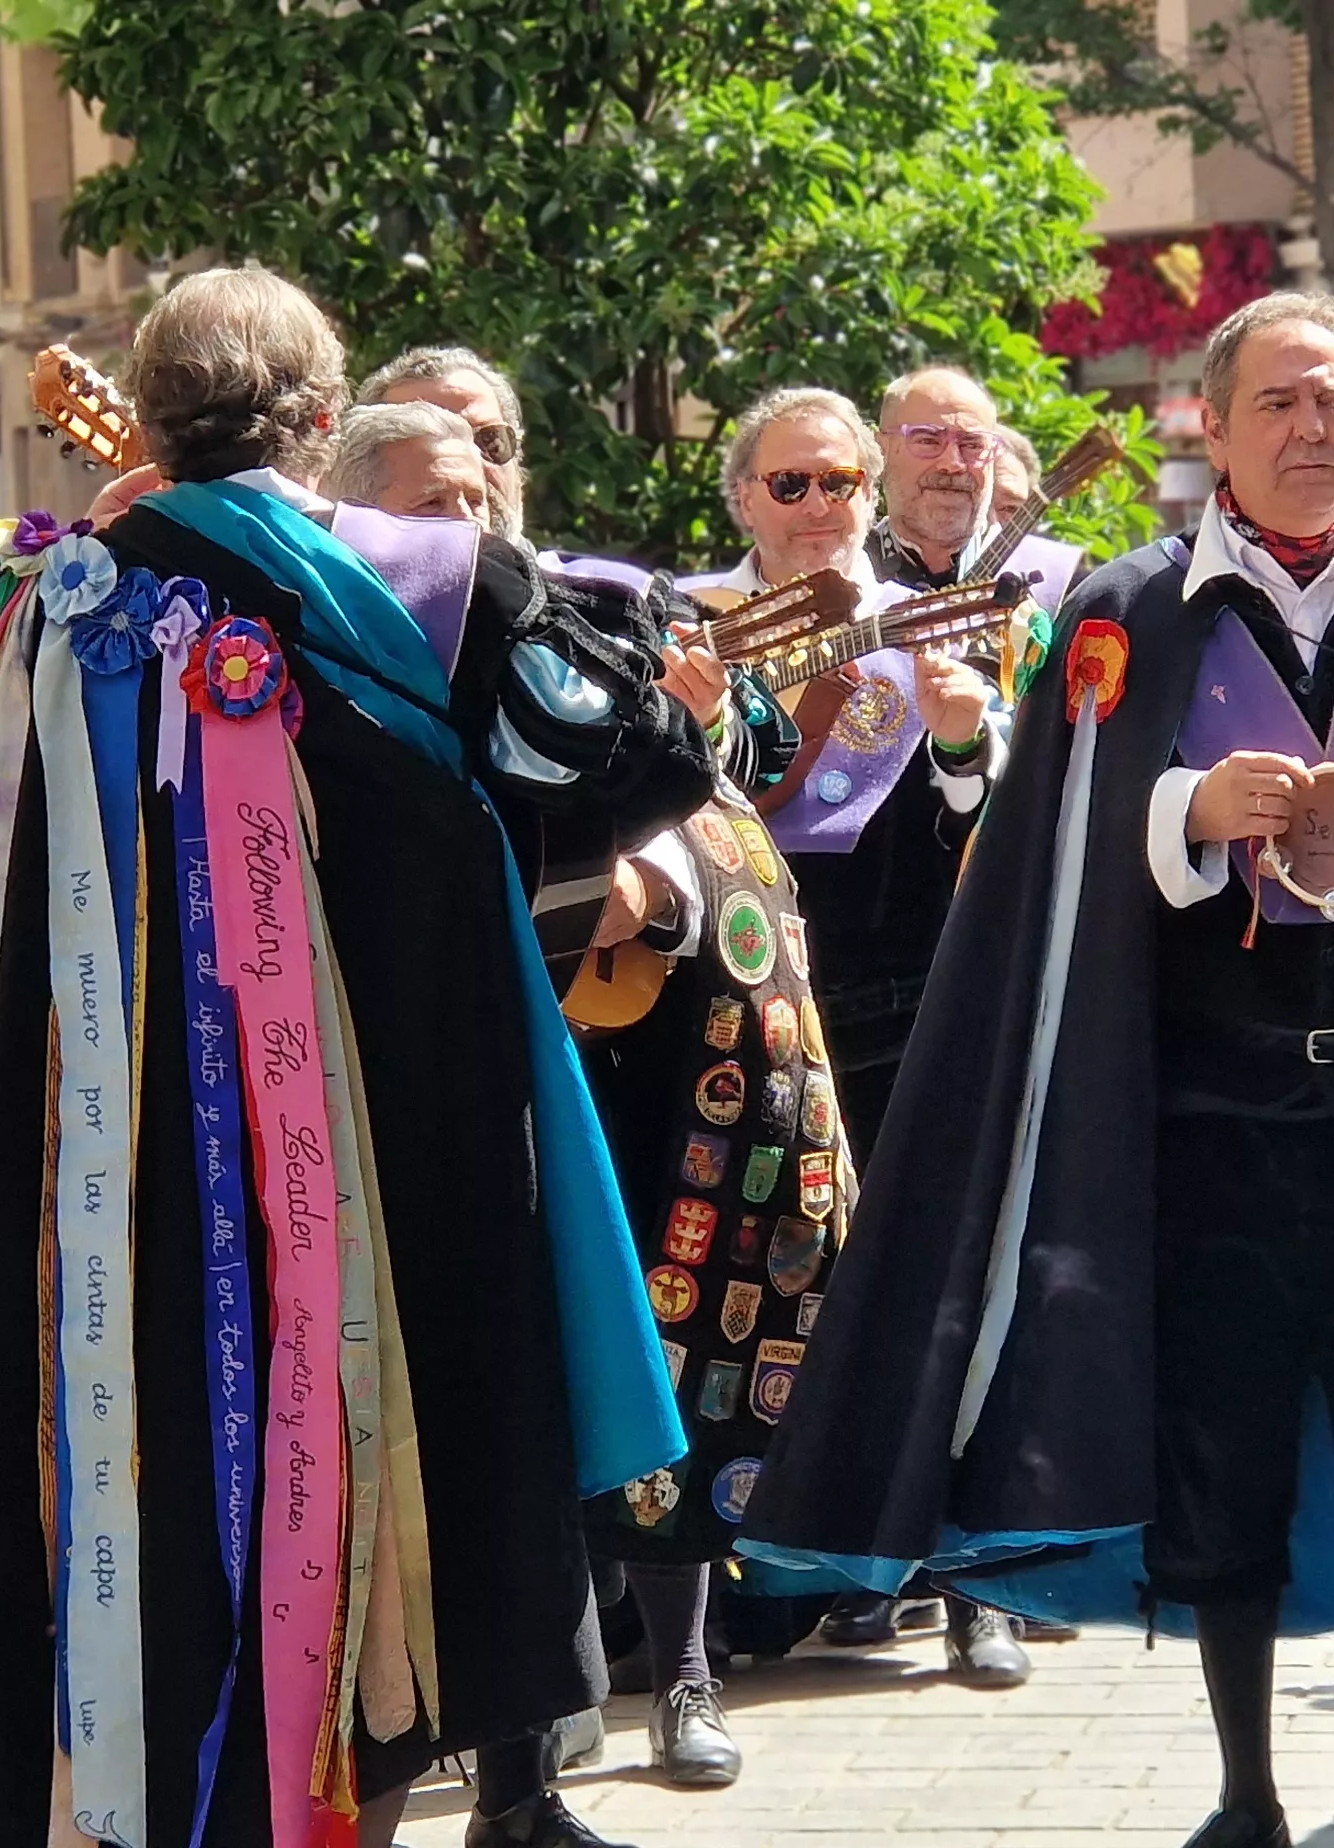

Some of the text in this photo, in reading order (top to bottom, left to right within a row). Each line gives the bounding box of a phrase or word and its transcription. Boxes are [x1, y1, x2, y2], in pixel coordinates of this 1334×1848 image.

[186, 855, 213, 933] Hasta
[195, 950, 219, 984] el
[191, 1000, 229, 1089] infinito
[194, 1101, 221, 1132] y
[206, 1134, 228, 1190] más
[236, 801, 329, 1533] Following The Leader Angelito y Andres
[70, 869, 118, 1609] Me muero por las cintas de tu capa
[211, 1198, 235, 1257] allá
[216, 1276, 236, 1313] en
[216, 1321, 245, 1402] todos
[223, 1408, 250, 1454] los
